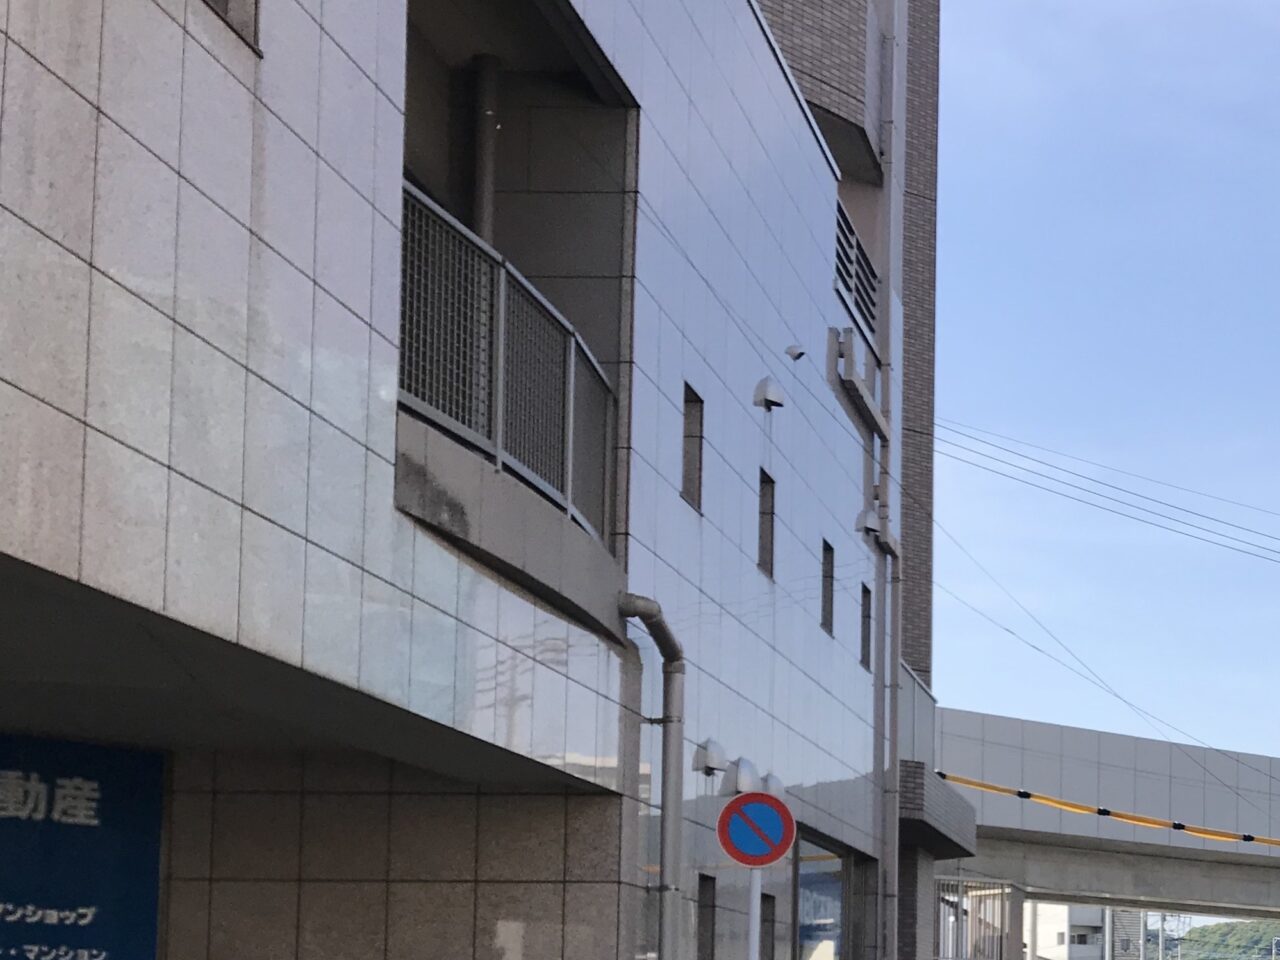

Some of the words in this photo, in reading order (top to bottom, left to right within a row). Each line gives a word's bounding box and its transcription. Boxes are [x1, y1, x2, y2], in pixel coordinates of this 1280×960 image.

[0, 903, 96, 925] ンショップ
